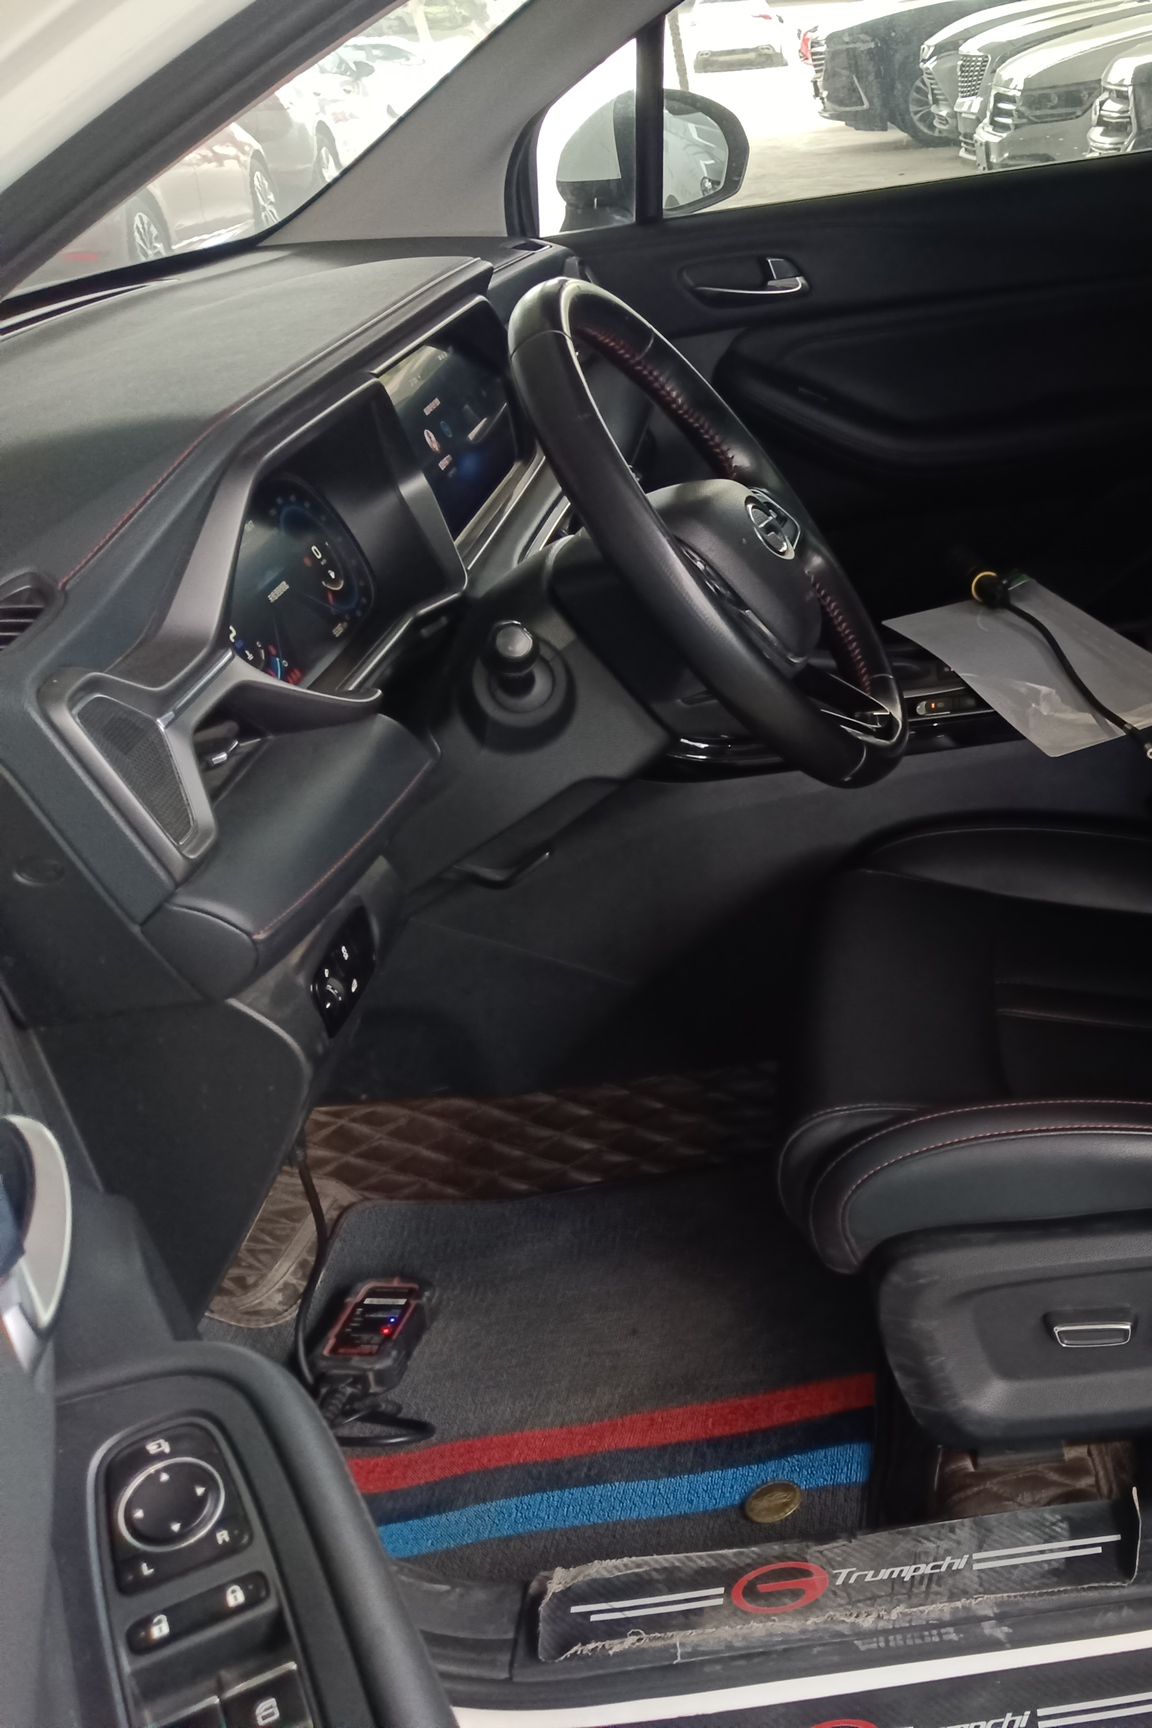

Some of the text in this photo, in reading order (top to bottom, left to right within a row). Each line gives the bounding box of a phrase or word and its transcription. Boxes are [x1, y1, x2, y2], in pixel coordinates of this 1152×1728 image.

[216, 1530, 230, 1544] R
[141, 1562, 155, 1576] L
[833, 1554, 969, 1586] Trumpchi
